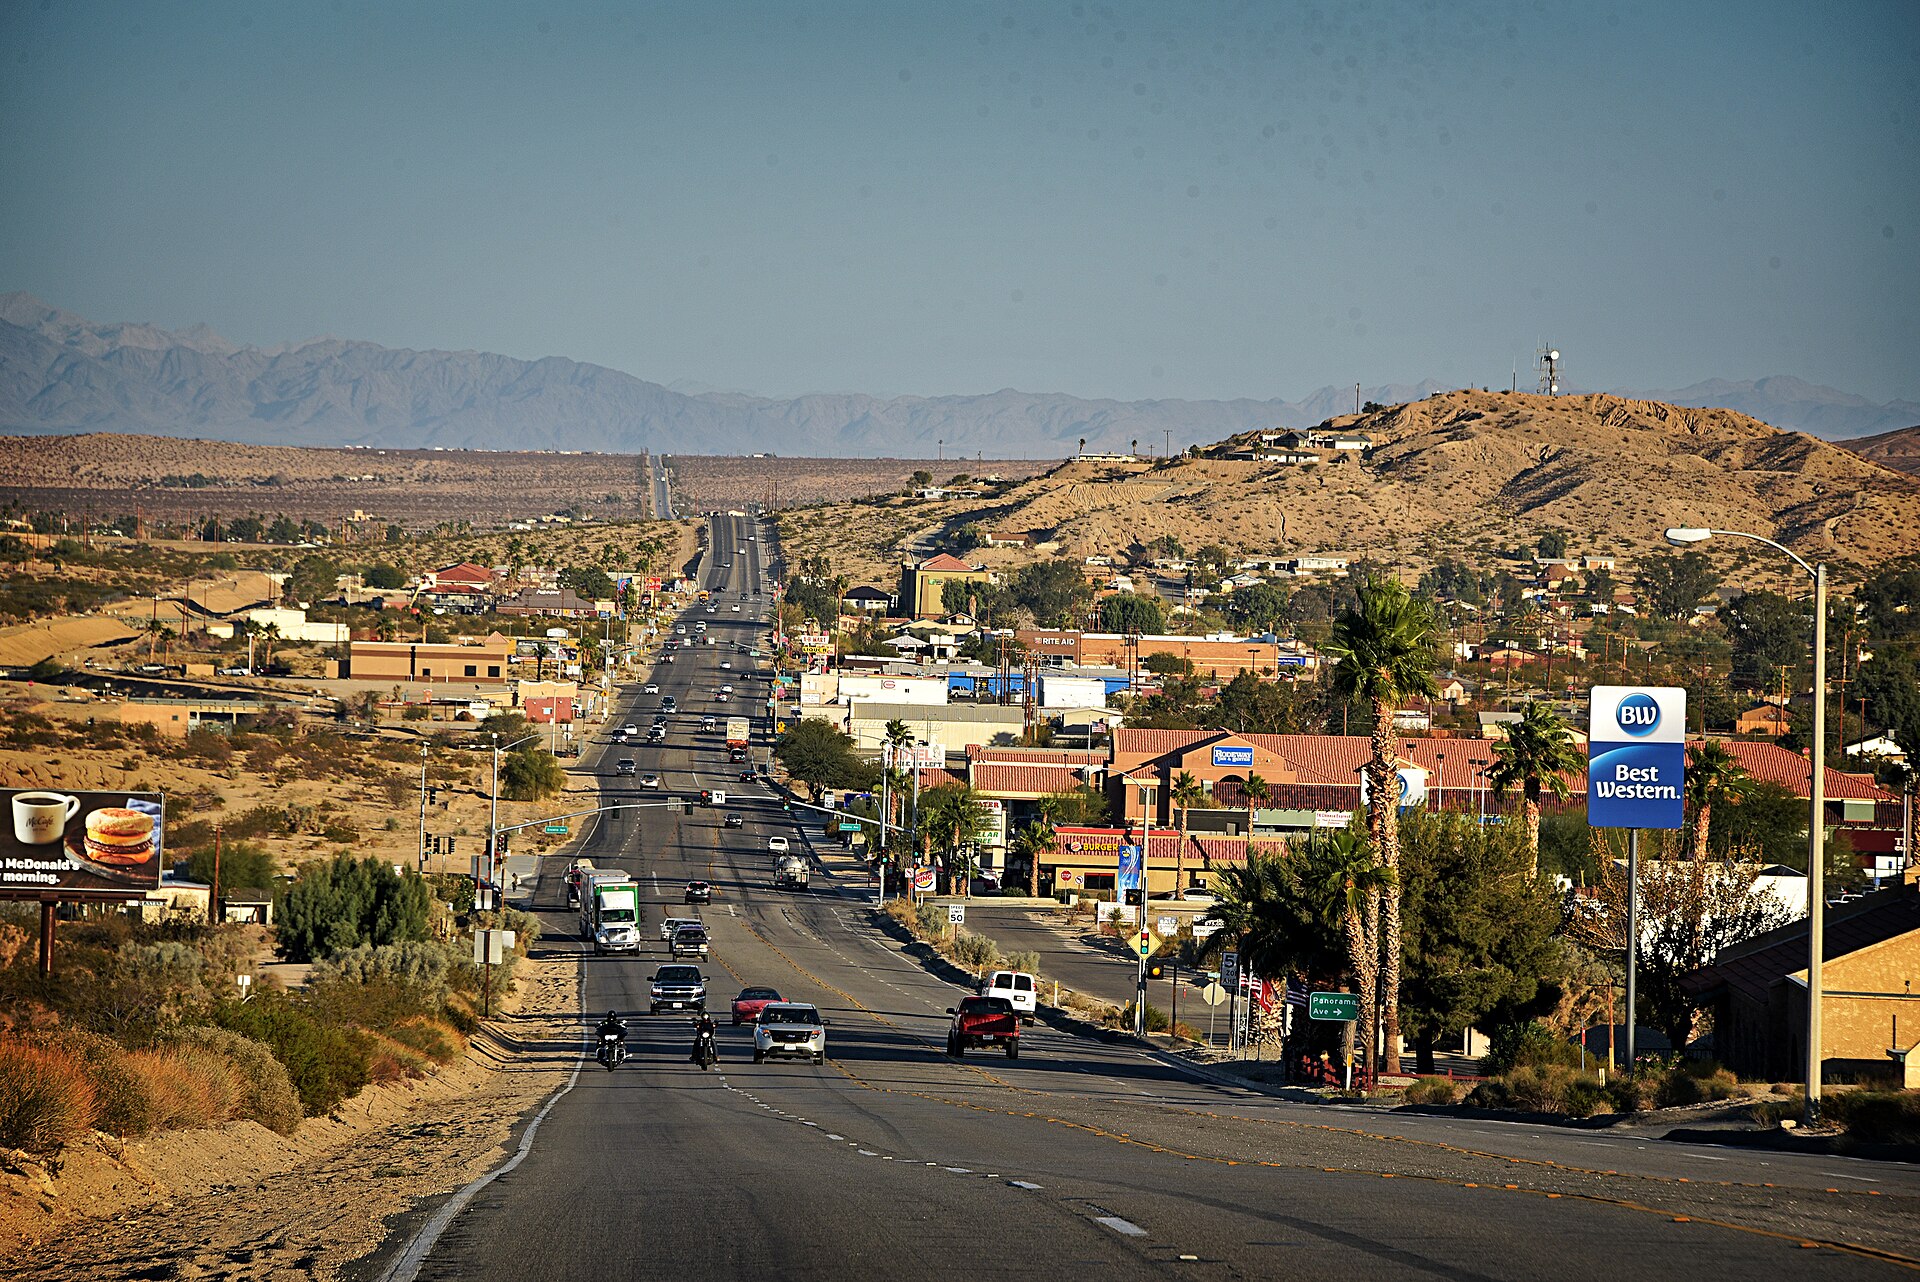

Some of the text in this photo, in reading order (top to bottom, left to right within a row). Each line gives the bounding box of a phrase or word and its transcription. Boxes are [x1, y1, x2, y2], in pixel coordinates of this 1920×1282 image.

[1042, 637, 1075, 646] RITE AID
[1621, 706, 1657, 725] BW
[1615, 764, 1659, 782] Best
[1596, 781, 1681, 800] Western.
[26, 815, 54, 828] McCafé
[1083, 843, 1119, 851] BURGER
[5, 858, 80, 871] McDonald's
[3, 871, 61, 885] morning.
[915, 874, 933, 884] KING
[950, 914, 963, 922] 50
[1225, 954, 1235, 968] 5
[1313, 997, 1357, 1005] Panorama
